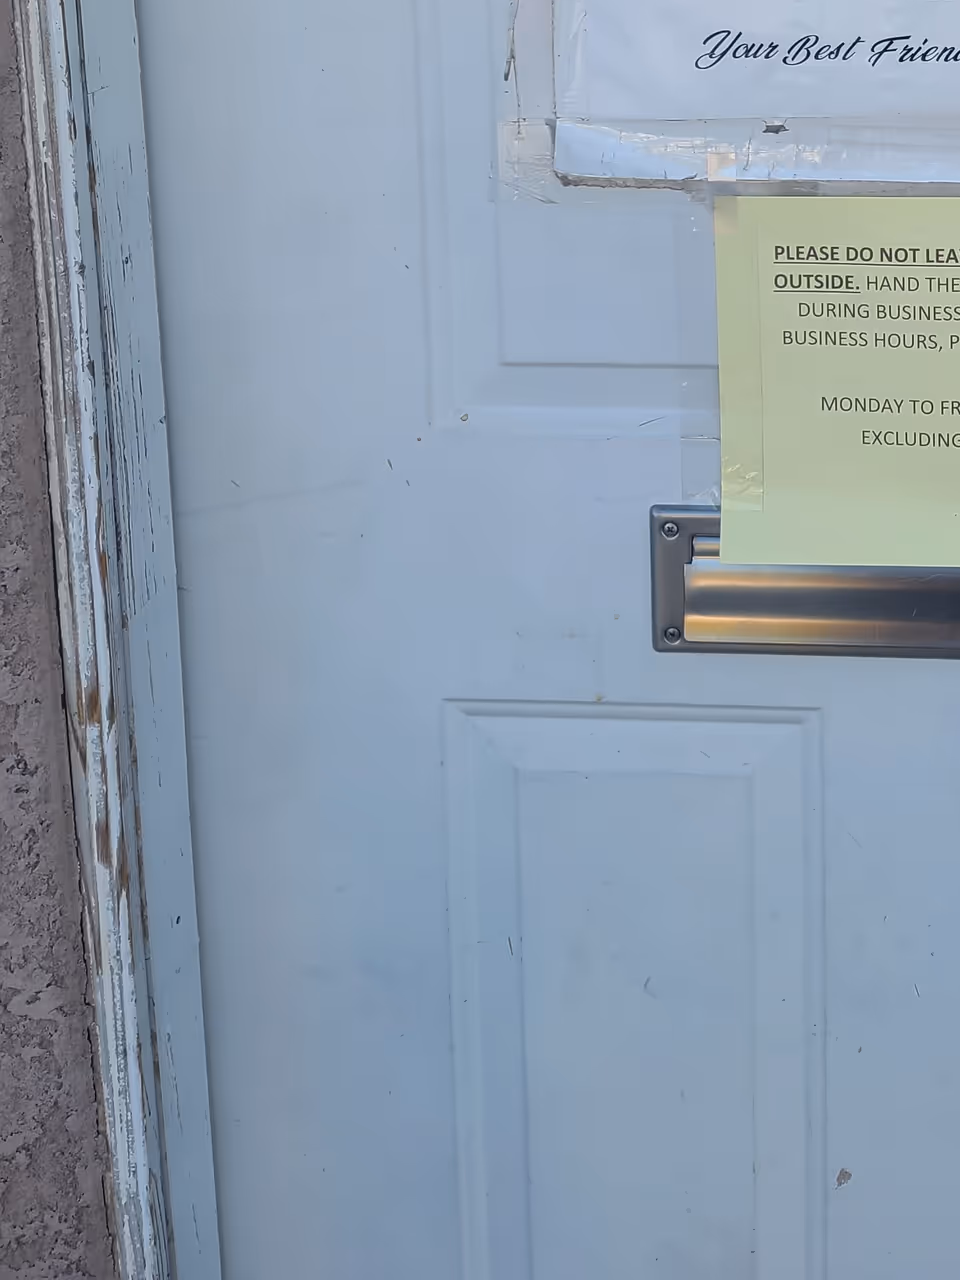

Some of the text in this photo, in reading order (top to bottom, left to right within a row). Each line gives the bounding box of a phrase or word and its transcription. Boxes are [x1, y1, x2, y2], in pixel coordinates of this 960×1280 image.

[694, 30, 779, 70] Your
[782, 35, 864, 67] Best
[774, 245, 839, 262] PLEASE
[846, 246, 874, 262] DO
[879, 247, 920, 263] NOT
[773, 273, 861, 290] OUTSIDE.
[866, 276, 920, 293] HAND
[798, 303, 870, 320] DURING
[782, 330, 868, 348] BUSINESS
[873, 332, 944, 352] HOURS,
[821, 397, 904, 414] MONDAY
[909, 399, 935, 415] TO
